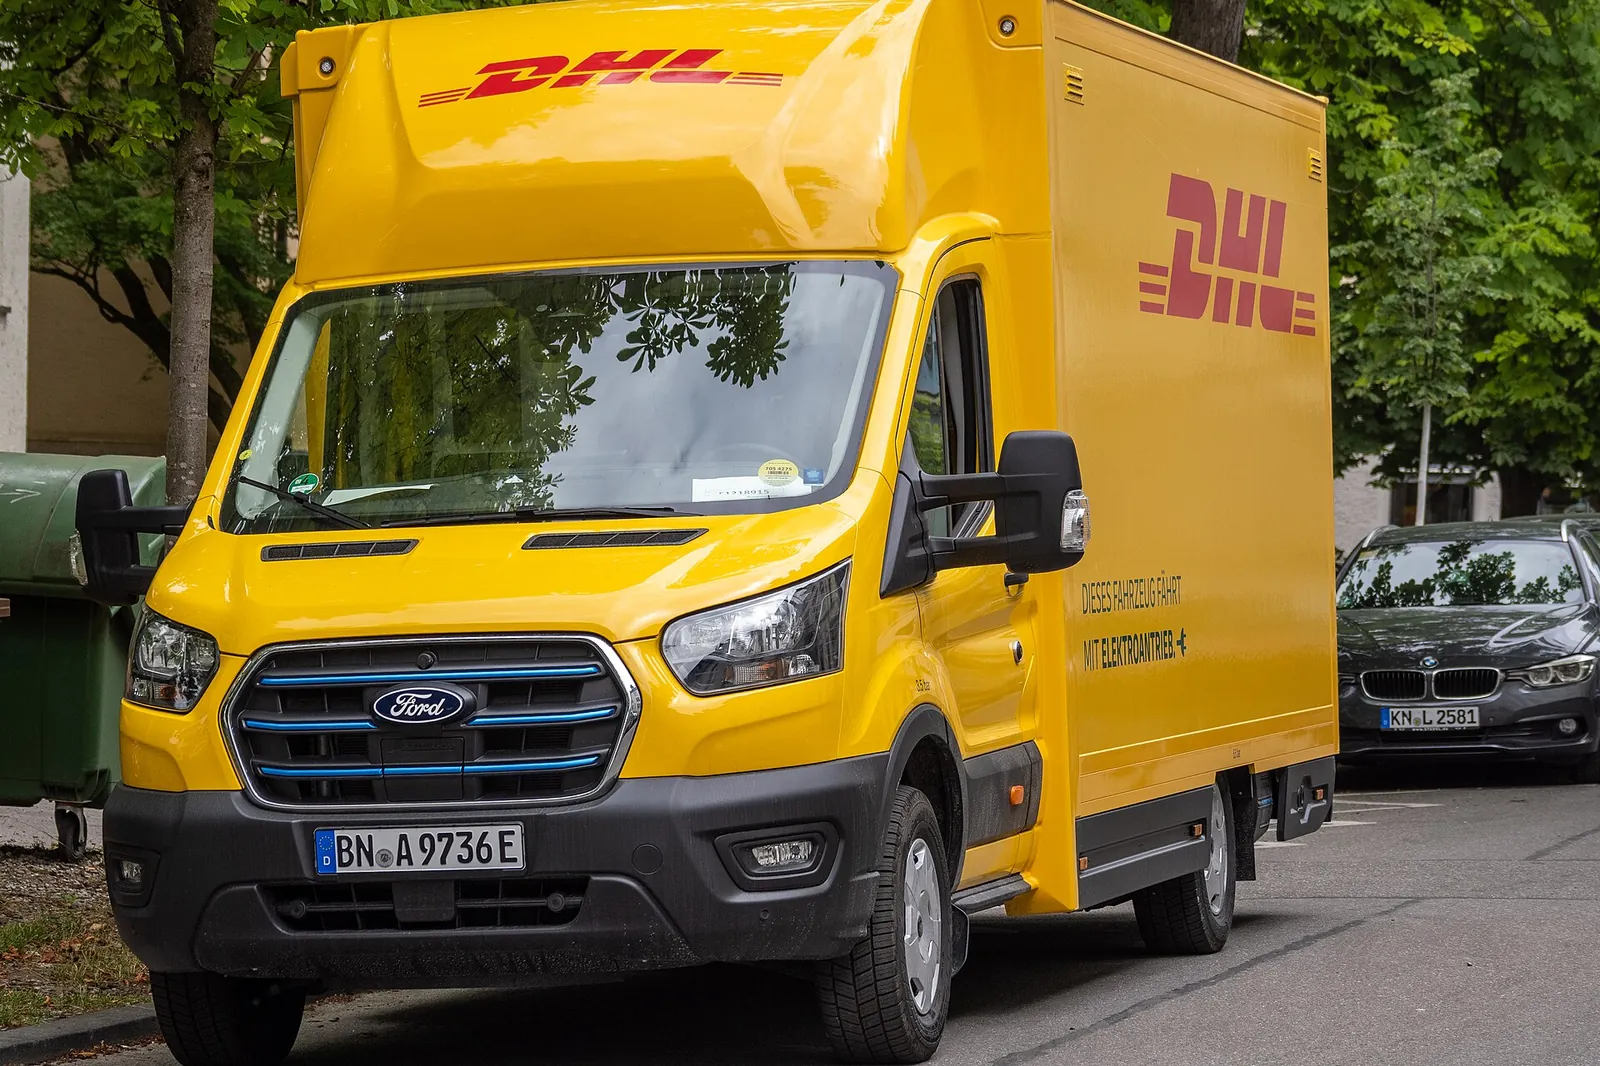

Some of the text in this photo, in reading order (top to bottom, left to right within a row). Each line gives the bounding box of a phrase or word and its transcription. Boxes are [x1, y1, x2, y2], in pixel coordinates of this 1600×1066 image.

[463, 48, 734, 100] DHL
[1166, 172, 1294, 334] DHL
[1082, 570, 1182, 615] DIESES FAHRZEUG FÄHRT
[1083, 629, 1177, 672] MIT ELEKTROANTRIEB.
[390, 693, 445, 717] Ford
[1391, 710, 1412, 726] KN
[1423, 710, 1433, 725] L
[1436, 709, 1477, 725] 2581
[323, 855, 332, 866] D
[336, 833, 374, 868] BN
